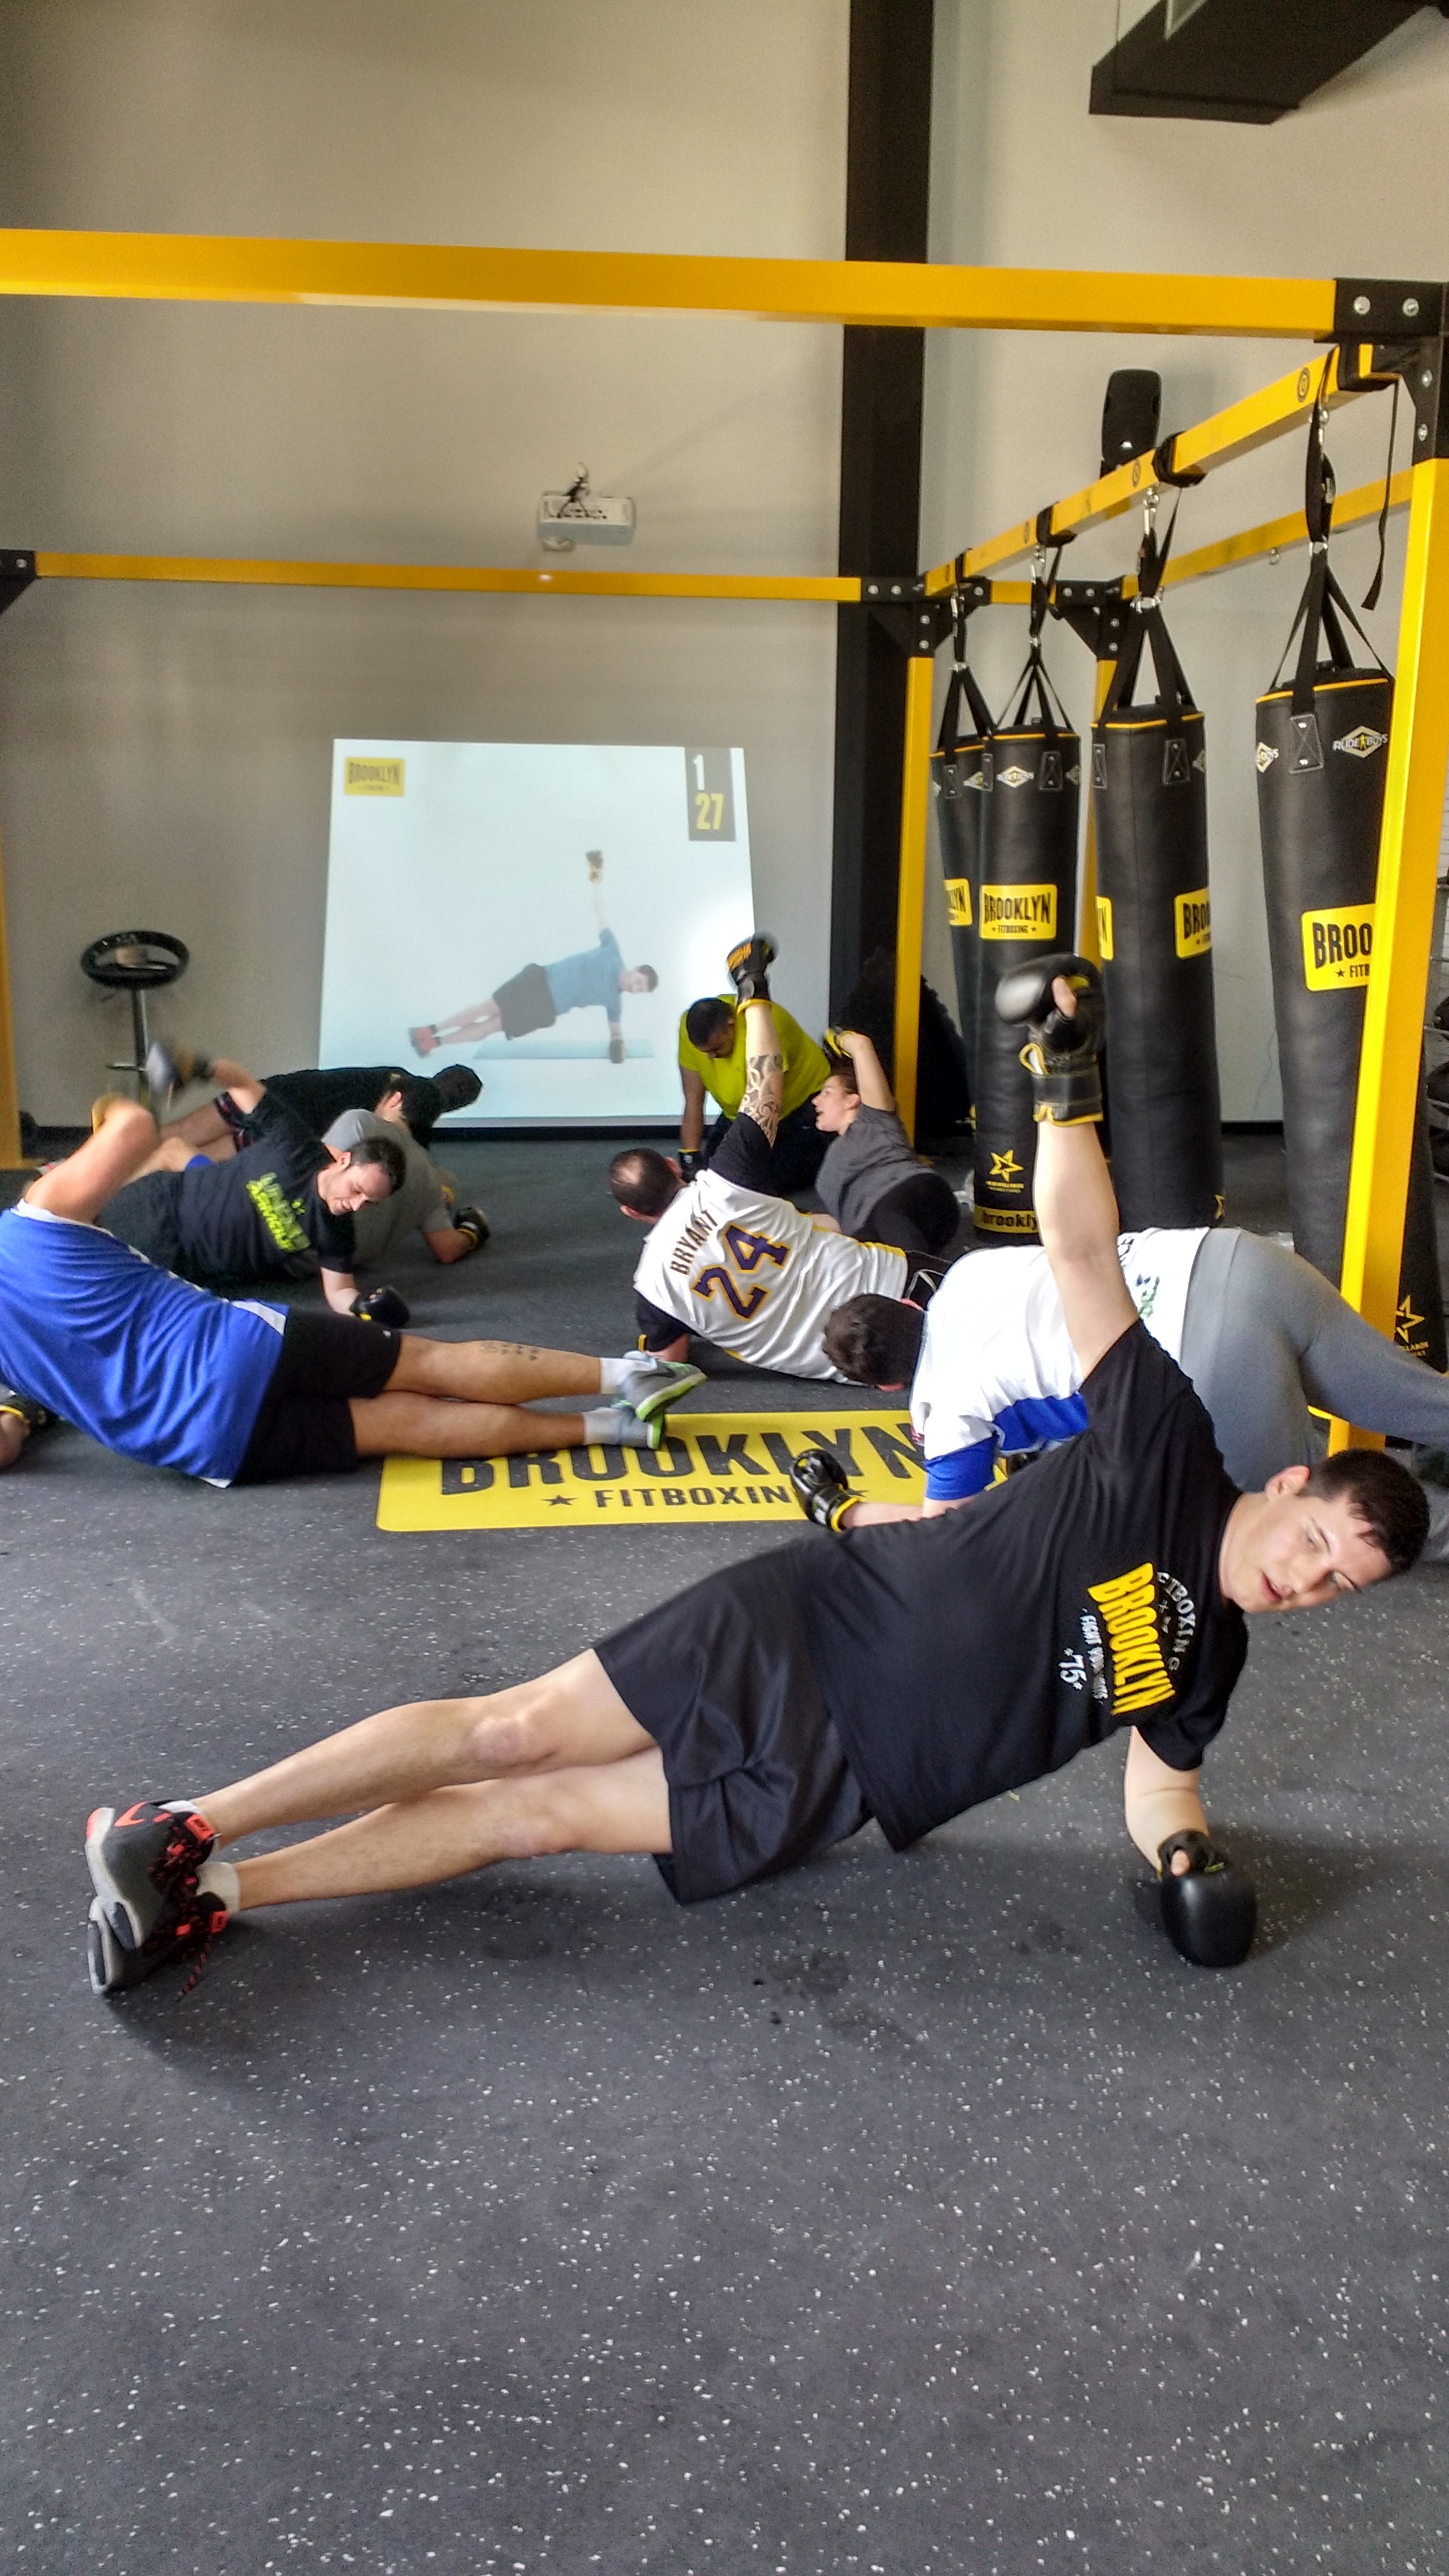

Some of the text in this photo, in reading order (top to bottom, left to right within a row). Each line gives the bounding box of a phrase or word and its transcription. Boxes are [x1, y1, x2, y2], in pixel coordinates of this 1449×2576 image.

[349, 762, 400, 785] BROOKLYN
[693, 754, 705, 791] 1
[695, 793, 724, 830] 27
[984, 892, 1051, 925] BROOKLYN
[669, 1208, 720, 1276] BRYANT
[690, 1222, 791, 1321] 24
[595, 1486, 793, 1508] FITBOXIN
[1087, 1561, 1175, 1716] BROOKLYN
